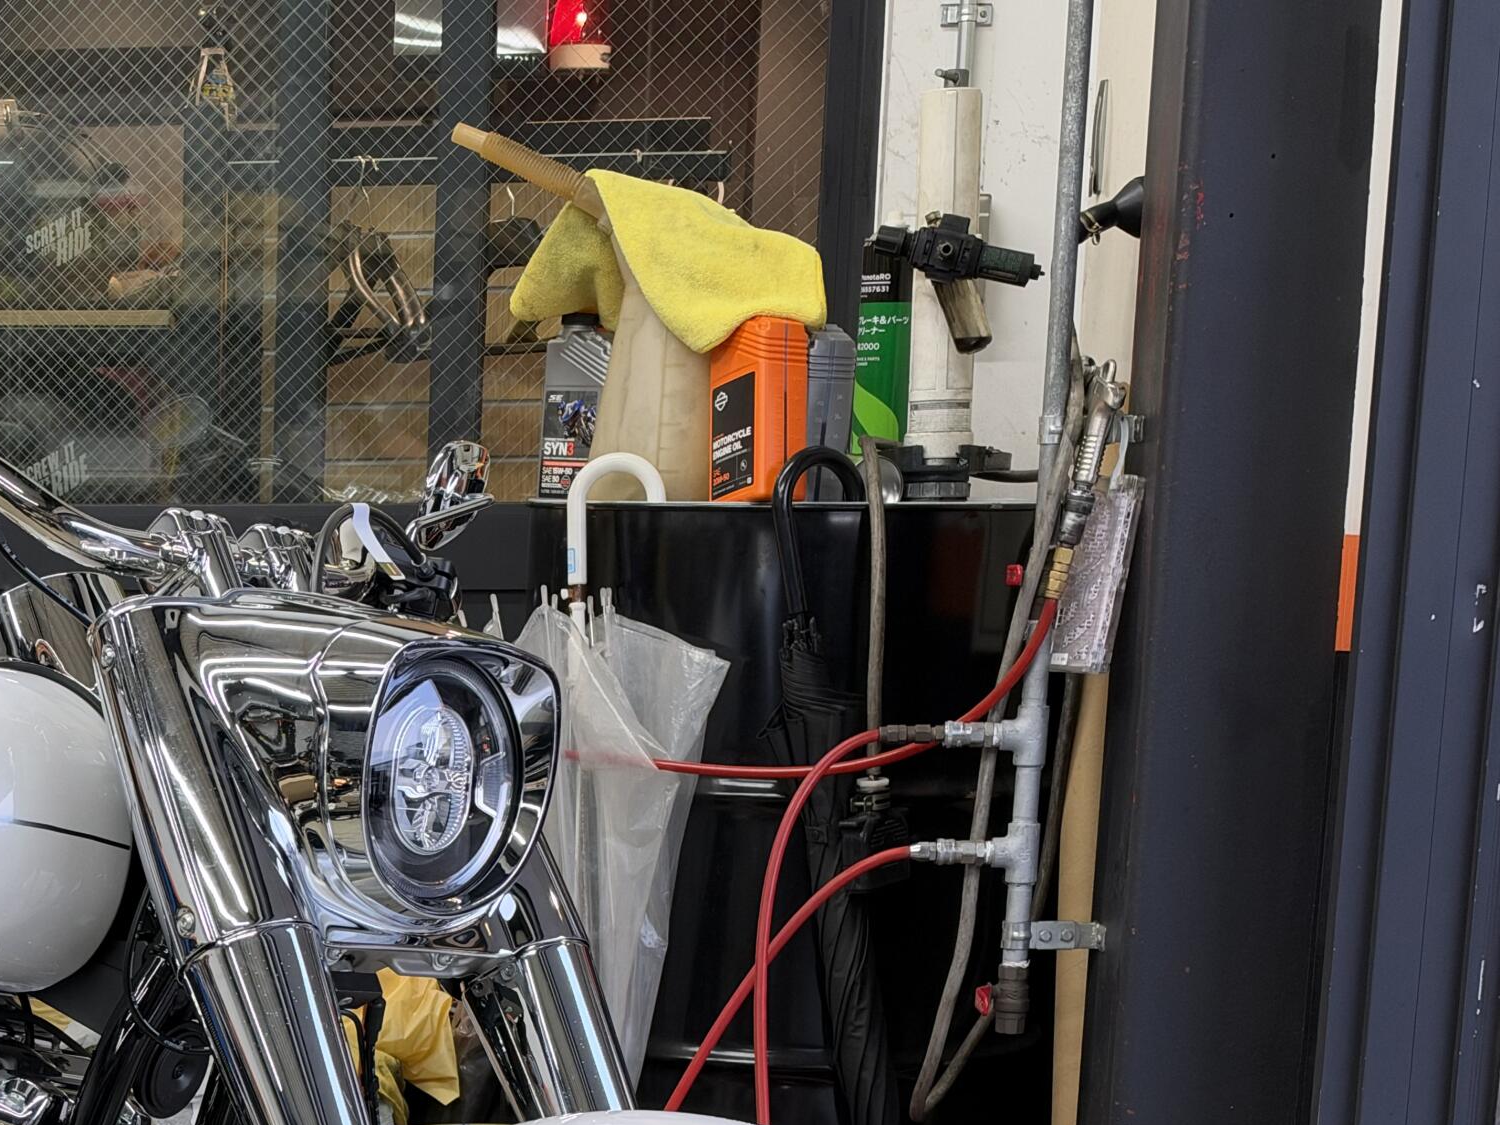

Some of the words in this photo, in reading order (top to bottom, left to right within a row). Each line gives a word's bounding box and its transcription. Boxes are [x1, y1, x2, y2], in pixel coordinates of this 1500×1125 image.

[25, 215, 67, 254] SCREW
[56, 221, 93, 267] RIDE
[543, 440, 575, 457] SYN3
[713, 426, 752, 451] MOTORCYCLE
[713, 444, 732, 461] ENGINE
[732, 440, 743, 452] OIL
[50, 452, 89, 498] RIDE
